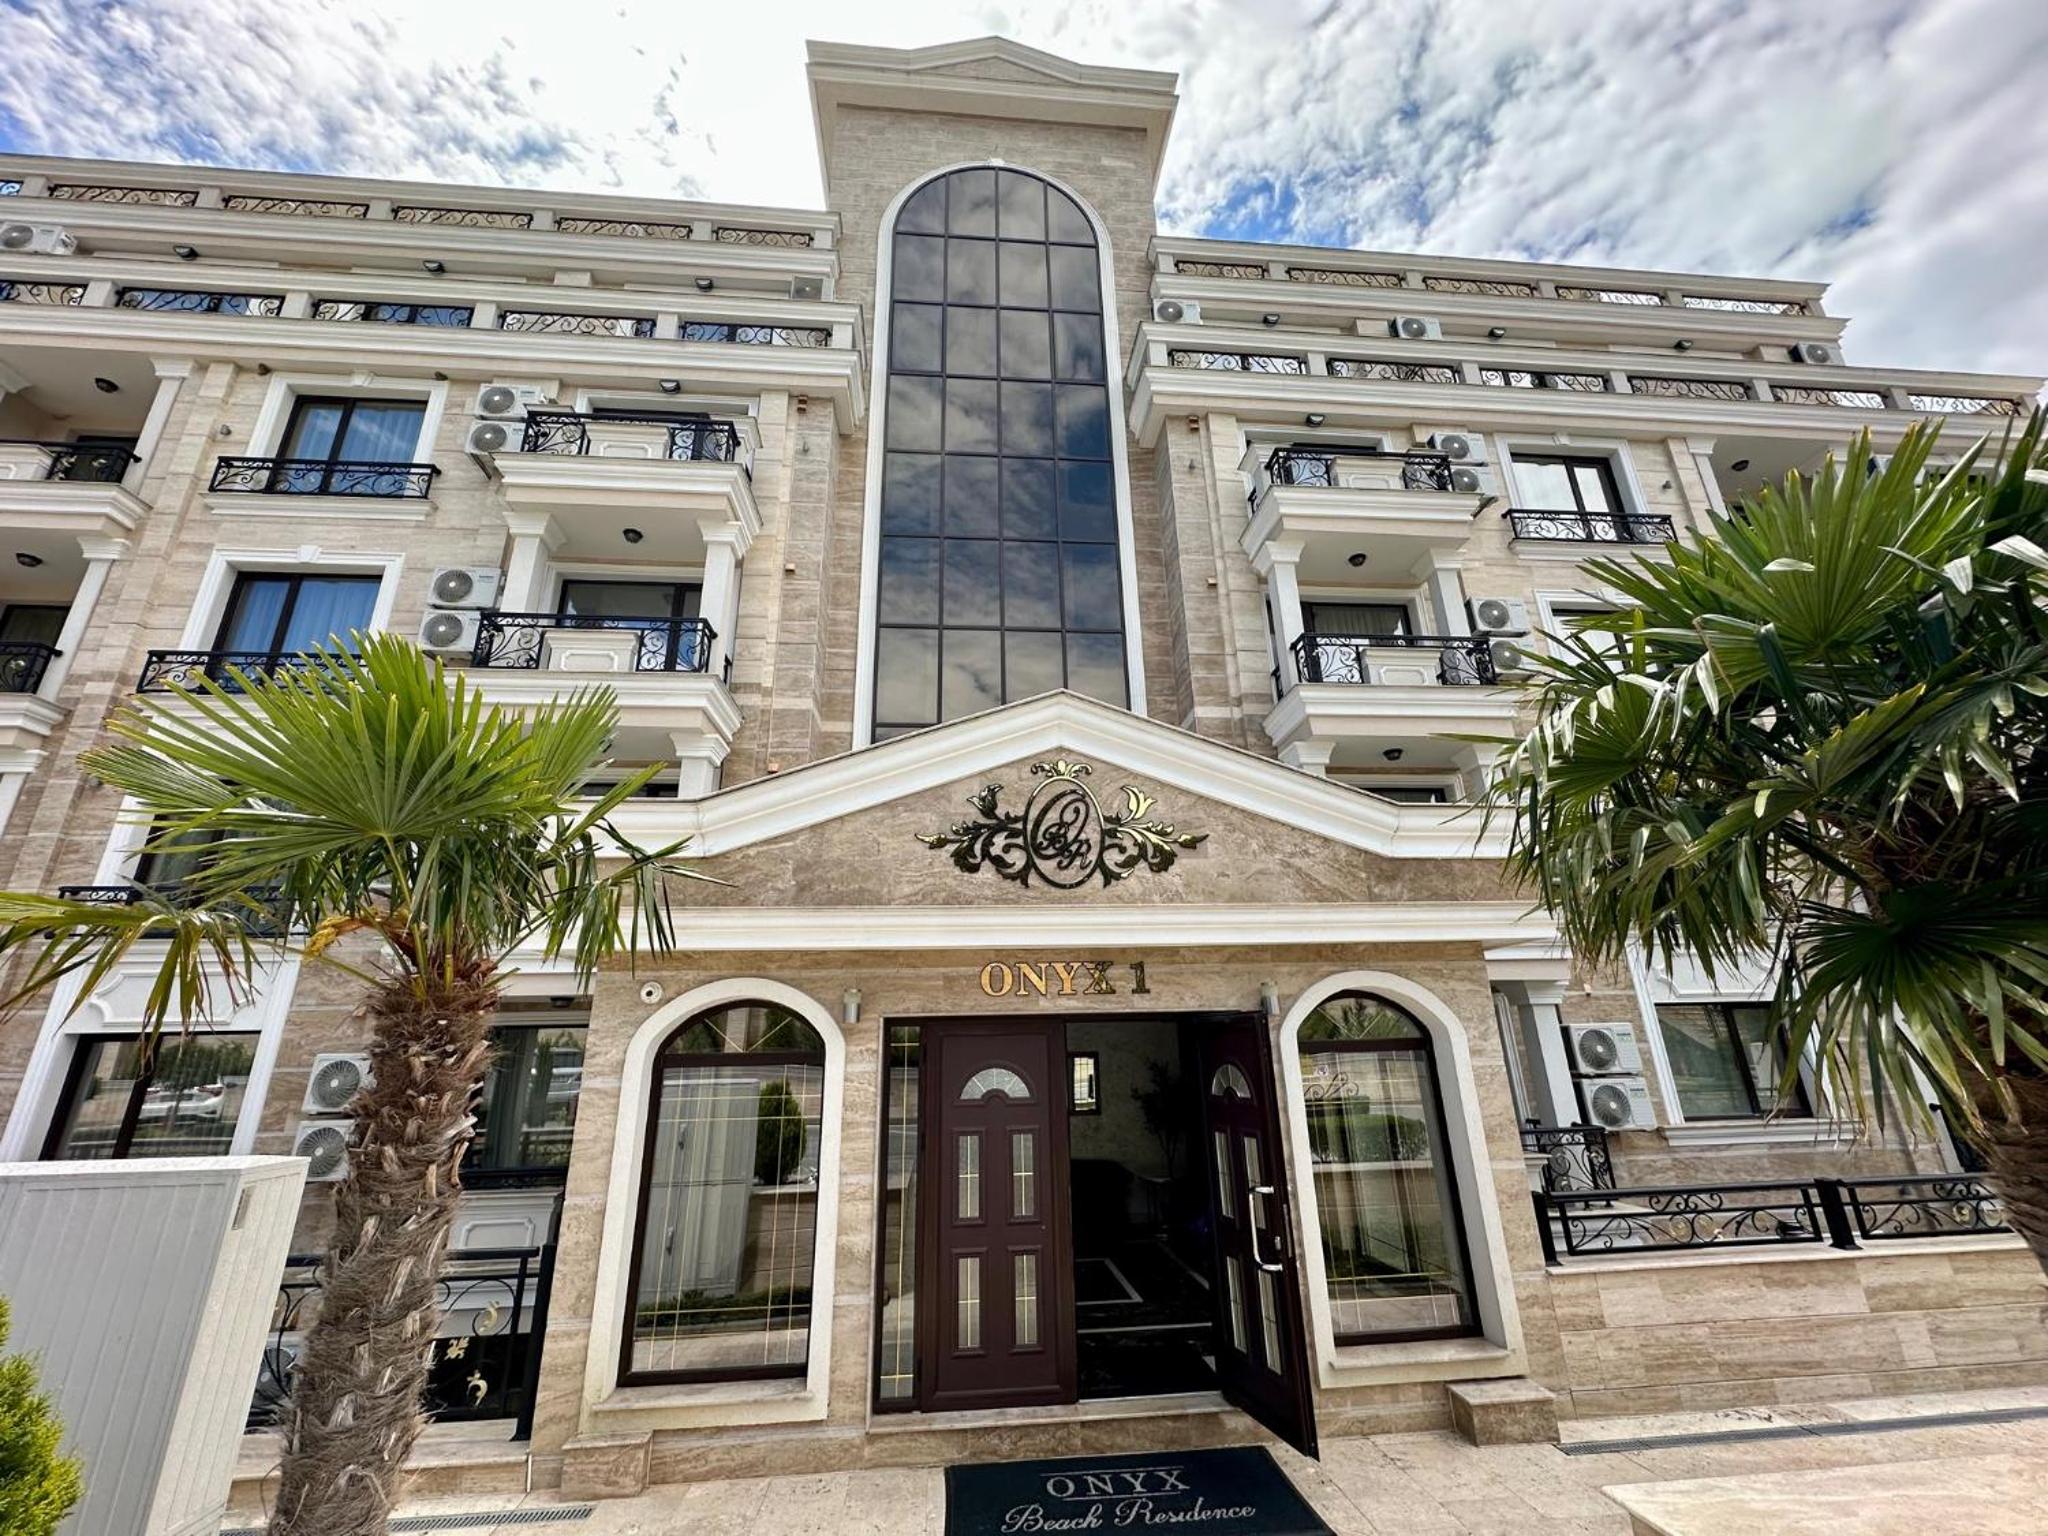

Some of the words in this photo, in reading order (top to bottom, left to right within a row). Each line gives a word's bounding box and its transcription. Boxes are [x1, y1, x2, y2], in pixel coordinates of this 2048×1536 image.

[980, 961, 1116, 997] ONYX
[1129, 961, 1150, 994] 1
[1046, 1470, 1190, 1498] ONYX
[1001, 1503, 1102, 1533] Beach
[1114, 1497, 1256, 1526] Residence
